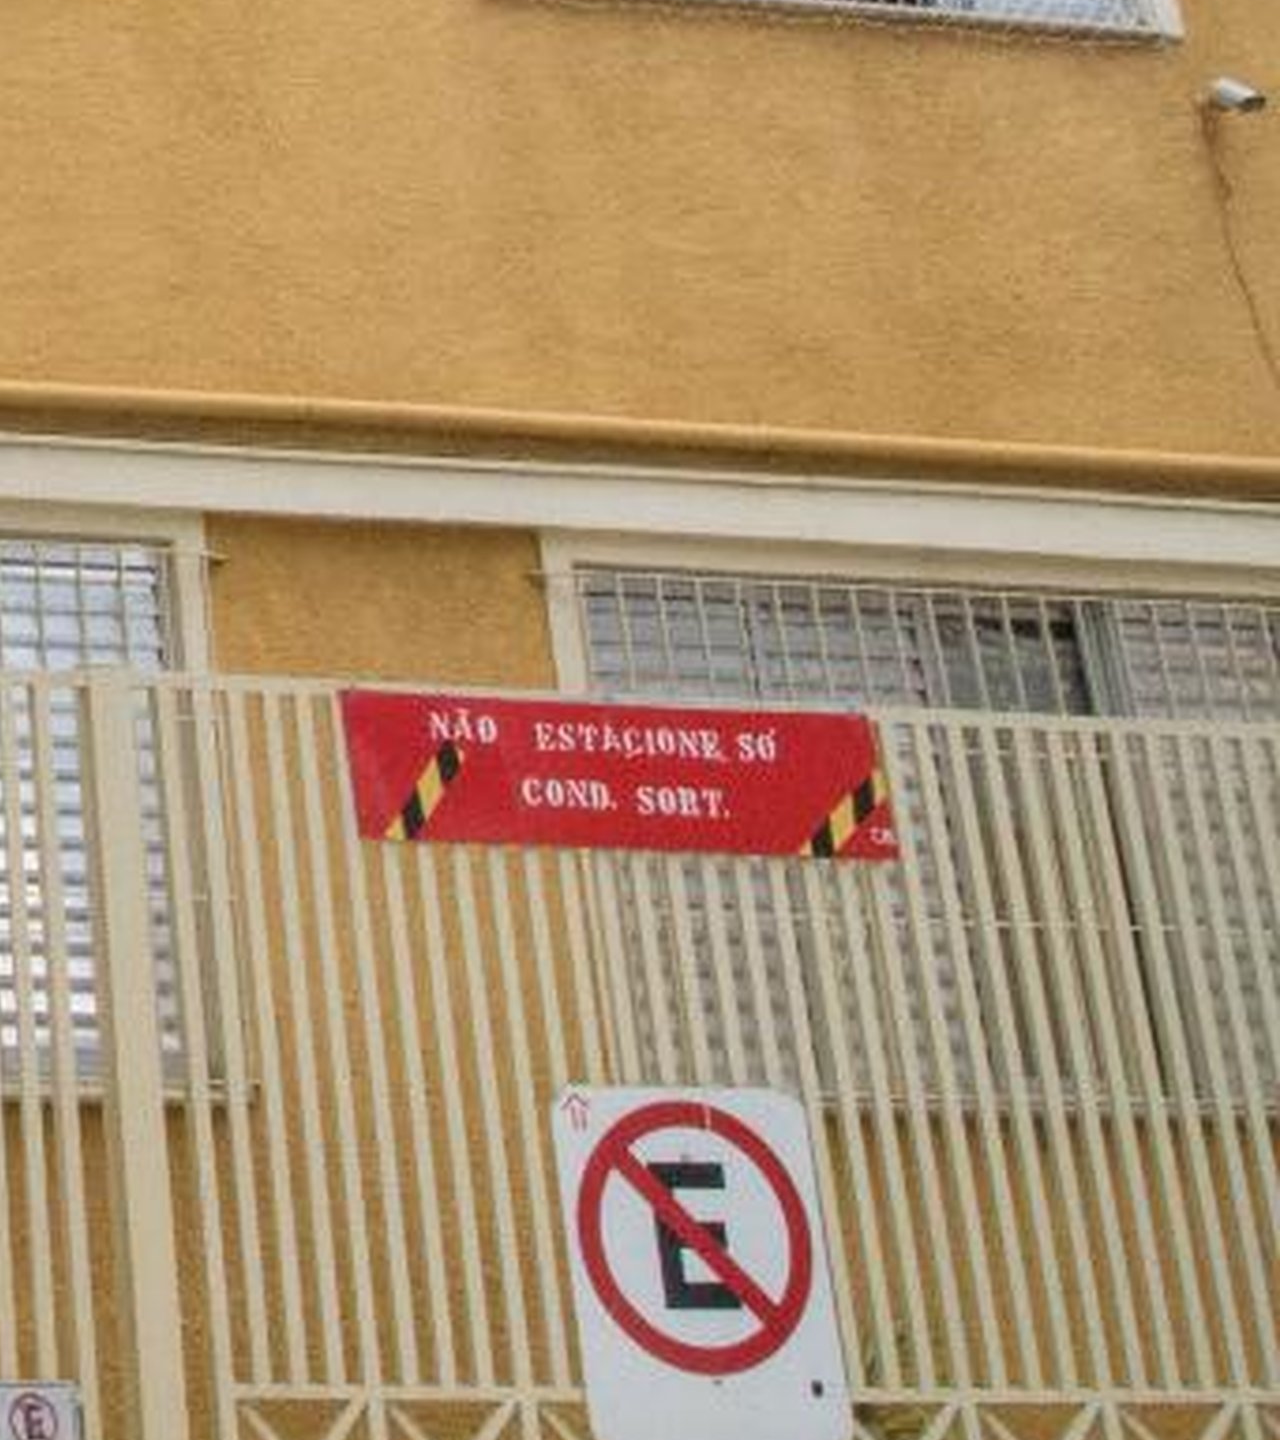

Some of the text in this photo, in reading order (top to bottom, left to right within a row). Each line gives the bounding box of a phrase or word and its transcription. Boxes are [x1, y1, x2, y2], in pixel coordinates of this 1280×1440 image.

[428, 708, 776, 763] NÃO ESTACIONE SÓ
[520, 776, 730, 819] COND. SORT.
[646, 1161, 744, 1309] E
